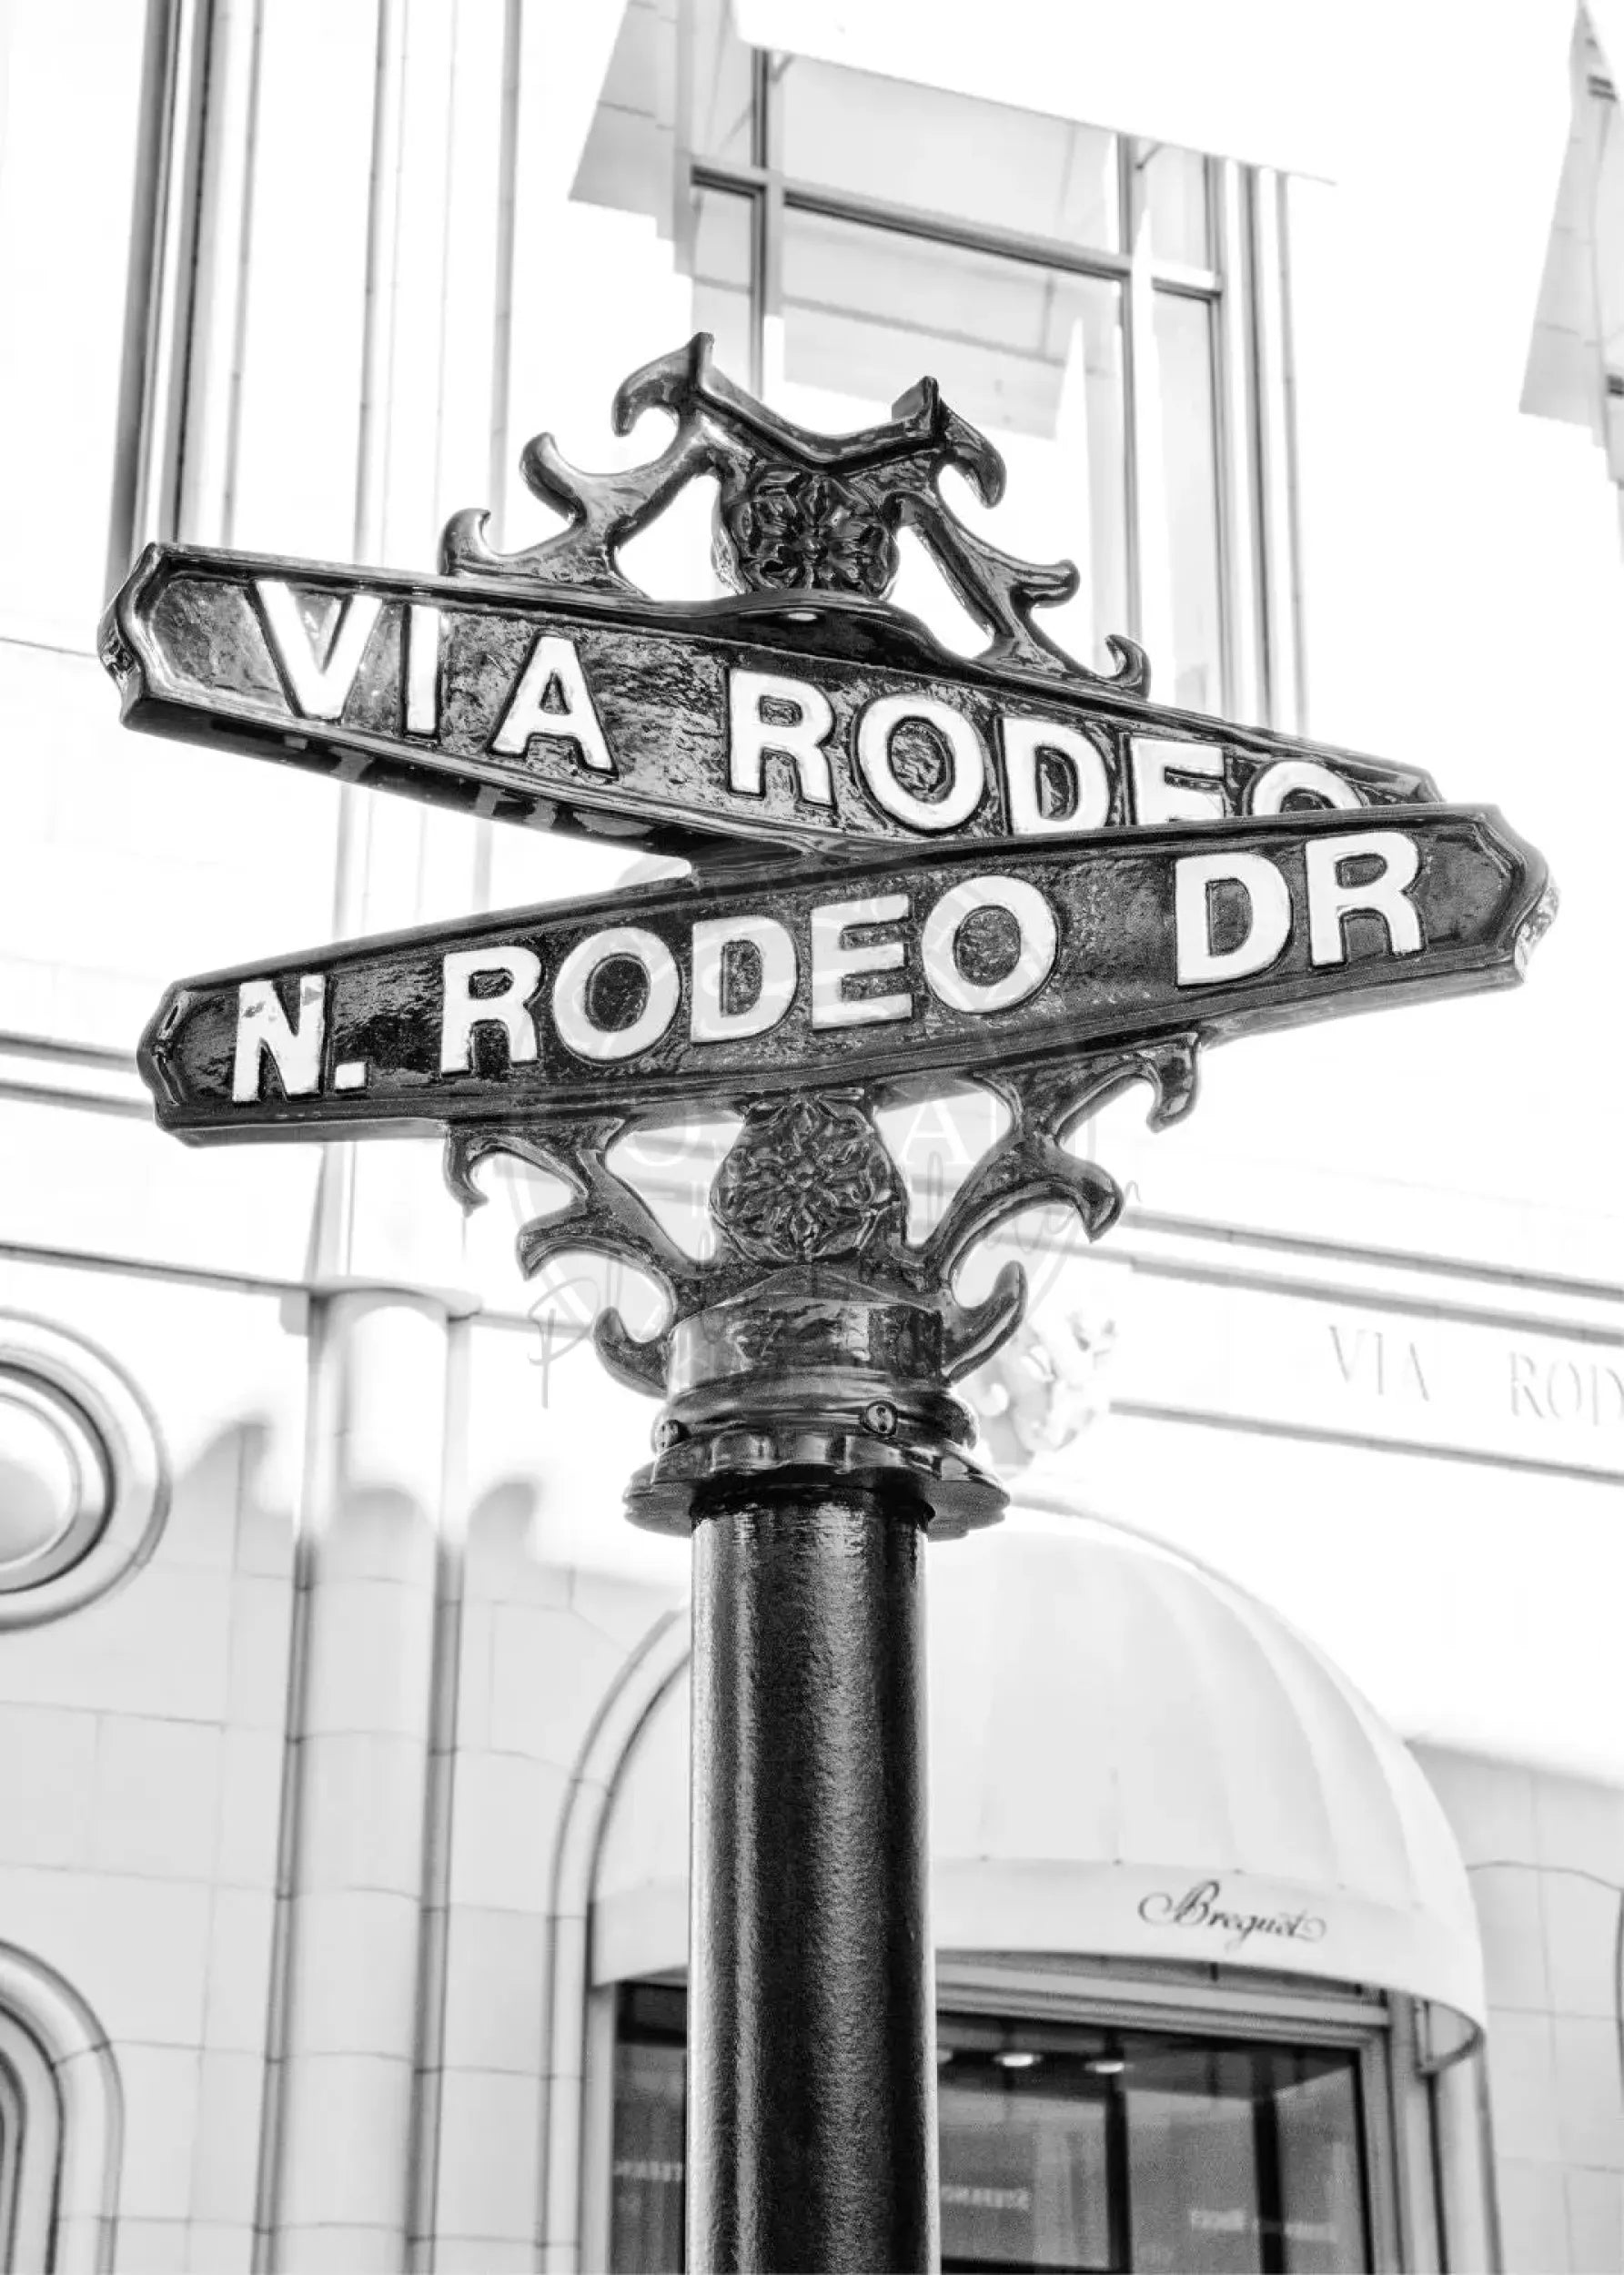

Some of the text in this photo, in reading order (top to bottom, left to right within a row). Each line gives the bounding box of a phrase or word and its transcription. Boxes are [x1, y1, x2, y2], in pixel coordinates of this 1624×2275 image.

[256, 581, 613, 770] VIA
[233, 832, 1425, 1103] N. RODEO DR
[1328, 1324, 1430, 1402] VIA
